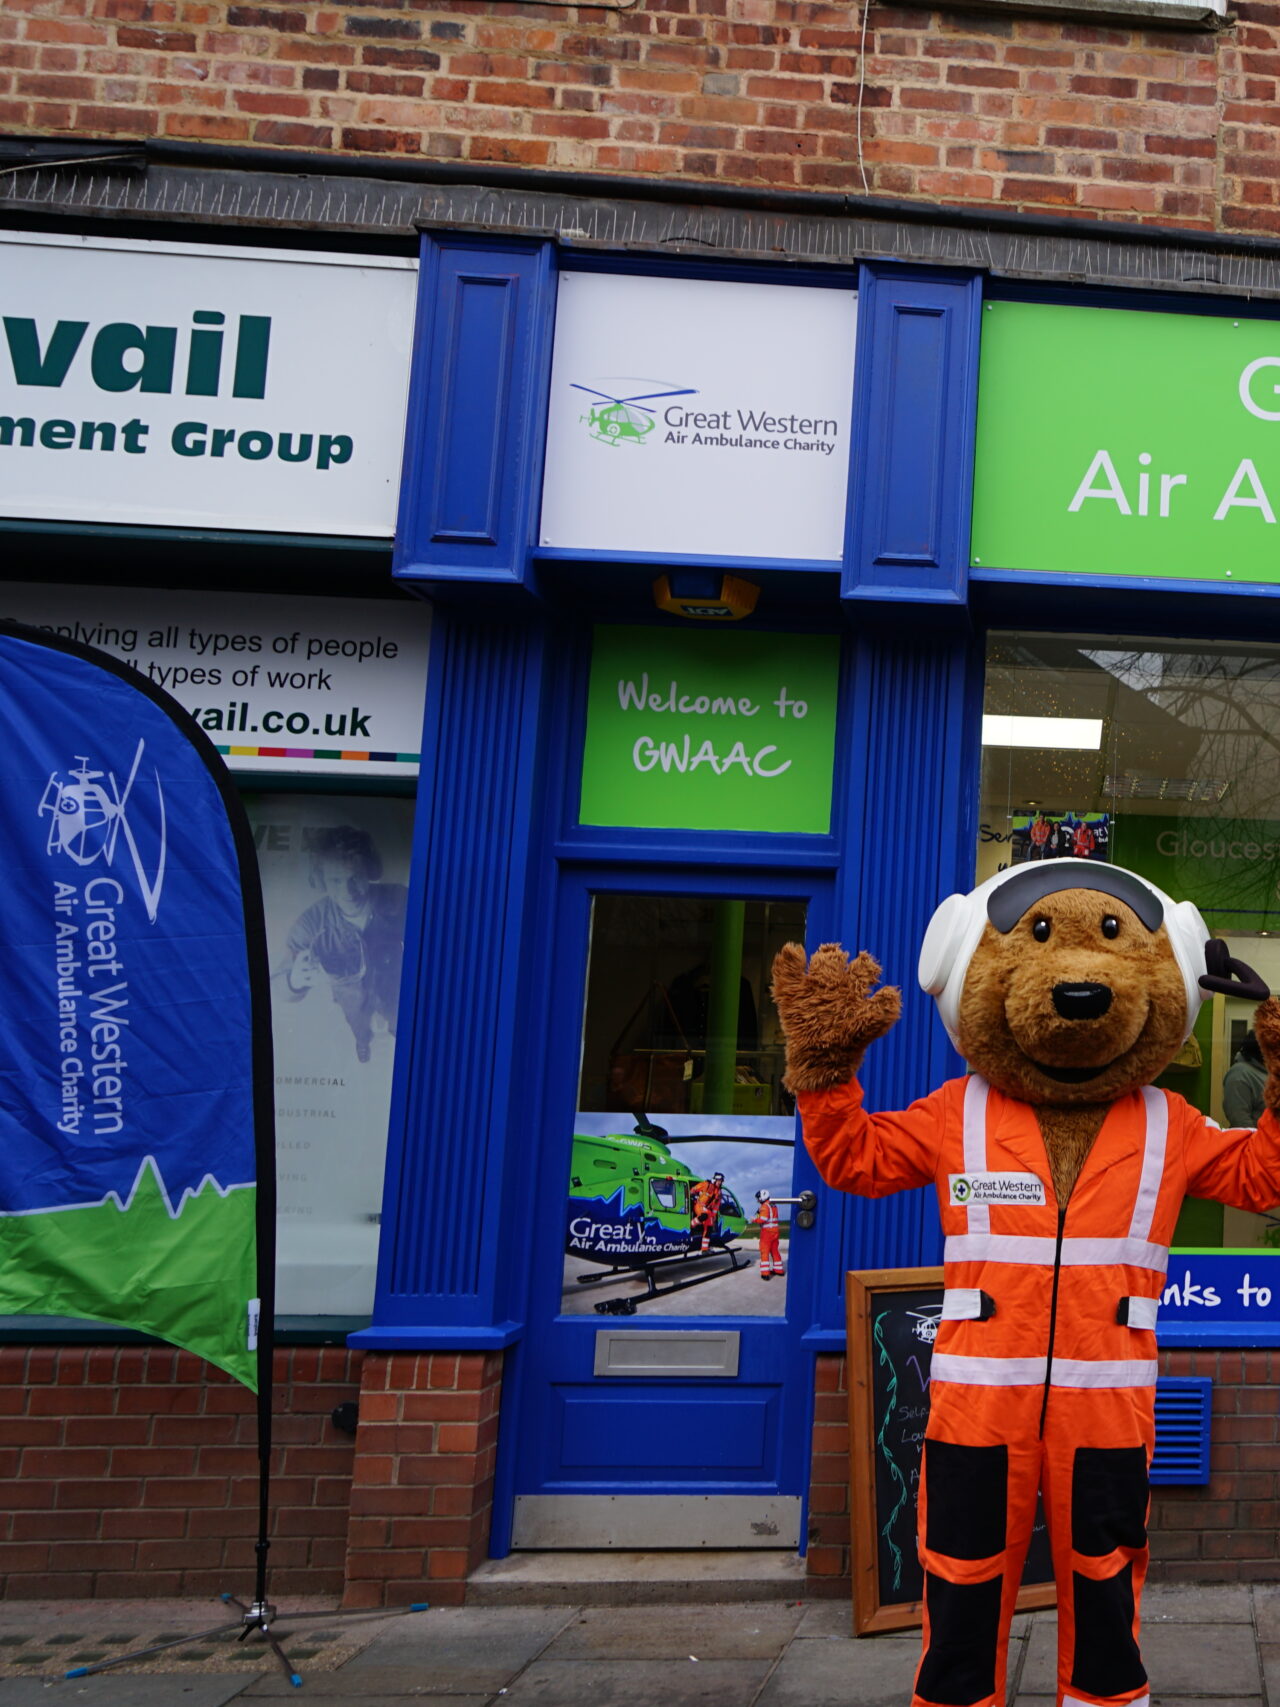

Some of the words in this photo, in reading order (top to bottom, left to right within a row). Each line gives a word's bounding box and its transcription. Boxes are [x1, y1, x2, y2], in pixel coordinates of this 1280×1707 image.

[664, 405, 731, 430] Great
[737, 409, 838, 436] Western
[171, 421, 354, 470] Group
[664, 431, 688, 444] Air
[692, 432, 780, 450] Ambulance
[784, 438, 835, 455] Charity
[1068, 450, 1187, 517] Air
[147, 626, 178, 648] all
[189, 628, 262, 656] types
[272, 632, 300, 654] of
[306, 636, 399, 662] people
[148, 661, 222, 690] types
[232, 665, 260, 687] of
[267, 668, 332, 690] work
[618, 671, 760, 717] Welcome
[774, 686, 808, 718] to
[633, 734, 792, 777] GWAAC
[54, 881, 78, 916] Air
[84, 877, 124, 977] Great
[55, 922, 82, 1053] Ambulance
[89, 982, 129, 1135] Western
[57, 1057, 84, 1135] Charity
[276, 1075, 347, 1087] OMMERCIAL
[277, 1107, 337, 1119] DUSTRIAL
[972, 1180, 996, 1191] Great
[999, 1180, 1041, 1192] Western
[983, 1192, 1017, 1200] Ambulance
[1018, 1193, 1041, 1201] Charity
[569, 1217, 633, 1240] Great
[569, 1237, 593, 1250] Air
[595, 1240, 662, 1253] Ambulance
[663, 1242, 690, 1252] Charity
[1157, 1269, 1222, 1308] nks
[1236, 1273, 1272, 1308] to
